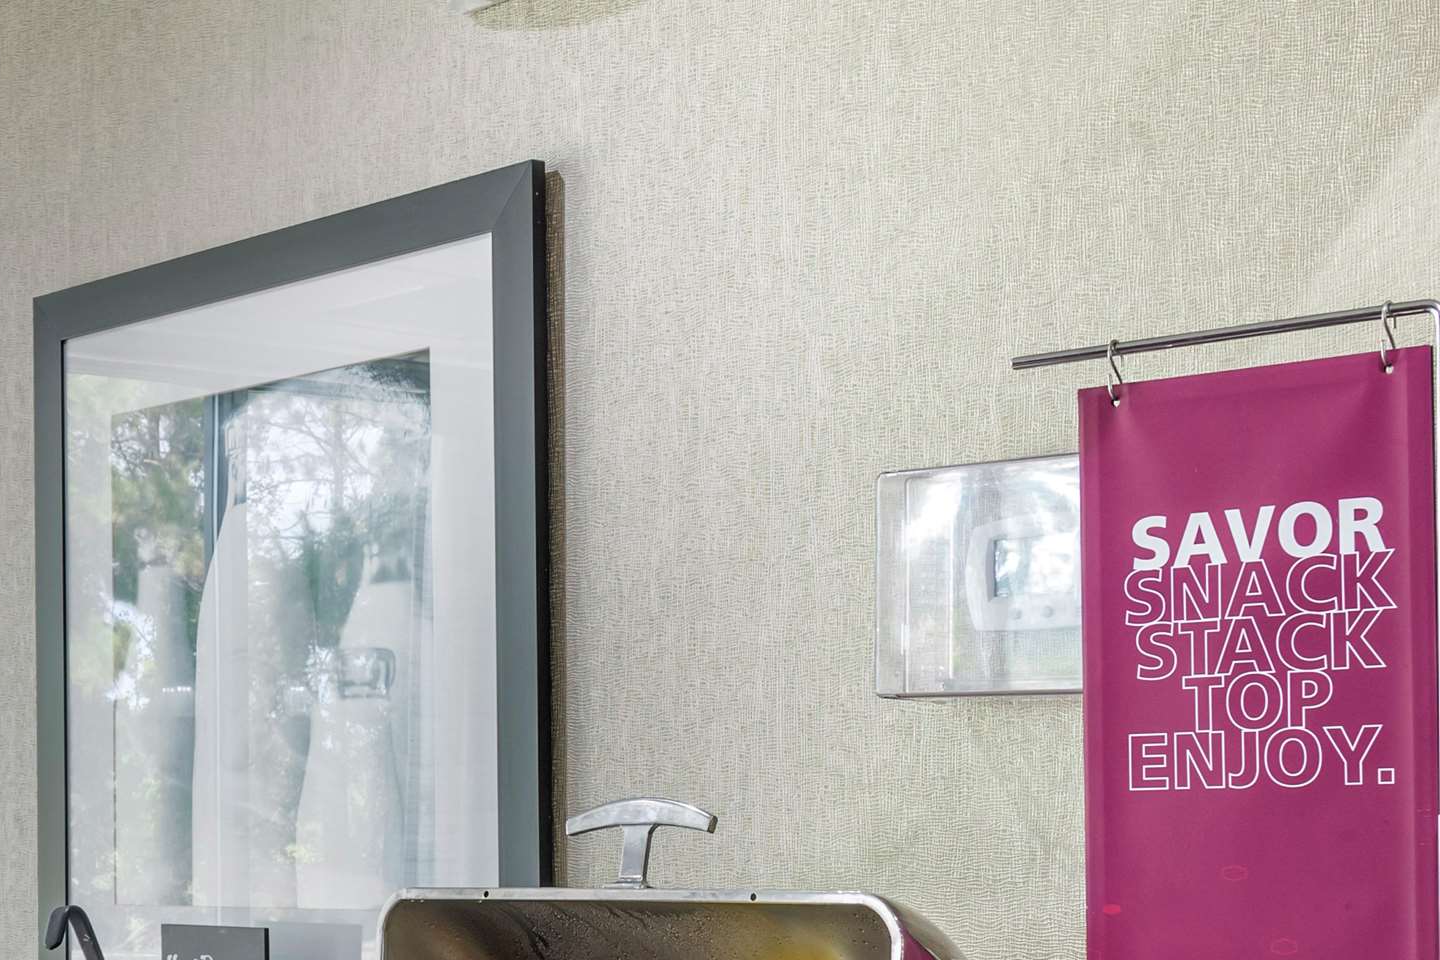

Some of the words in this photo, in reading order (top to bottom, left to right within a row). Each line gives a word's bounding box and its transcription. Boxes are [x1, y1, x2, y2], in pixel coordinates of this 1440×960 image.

[1131, 497, 1386, 570] SAVOR
[1124, 548, 1398, 626] SNACK
[1135, 608, 1387, 681] STACK
[1182, 670, 1334, 732] TOP
[1128, 724, 1396, 791] ENJOY.
